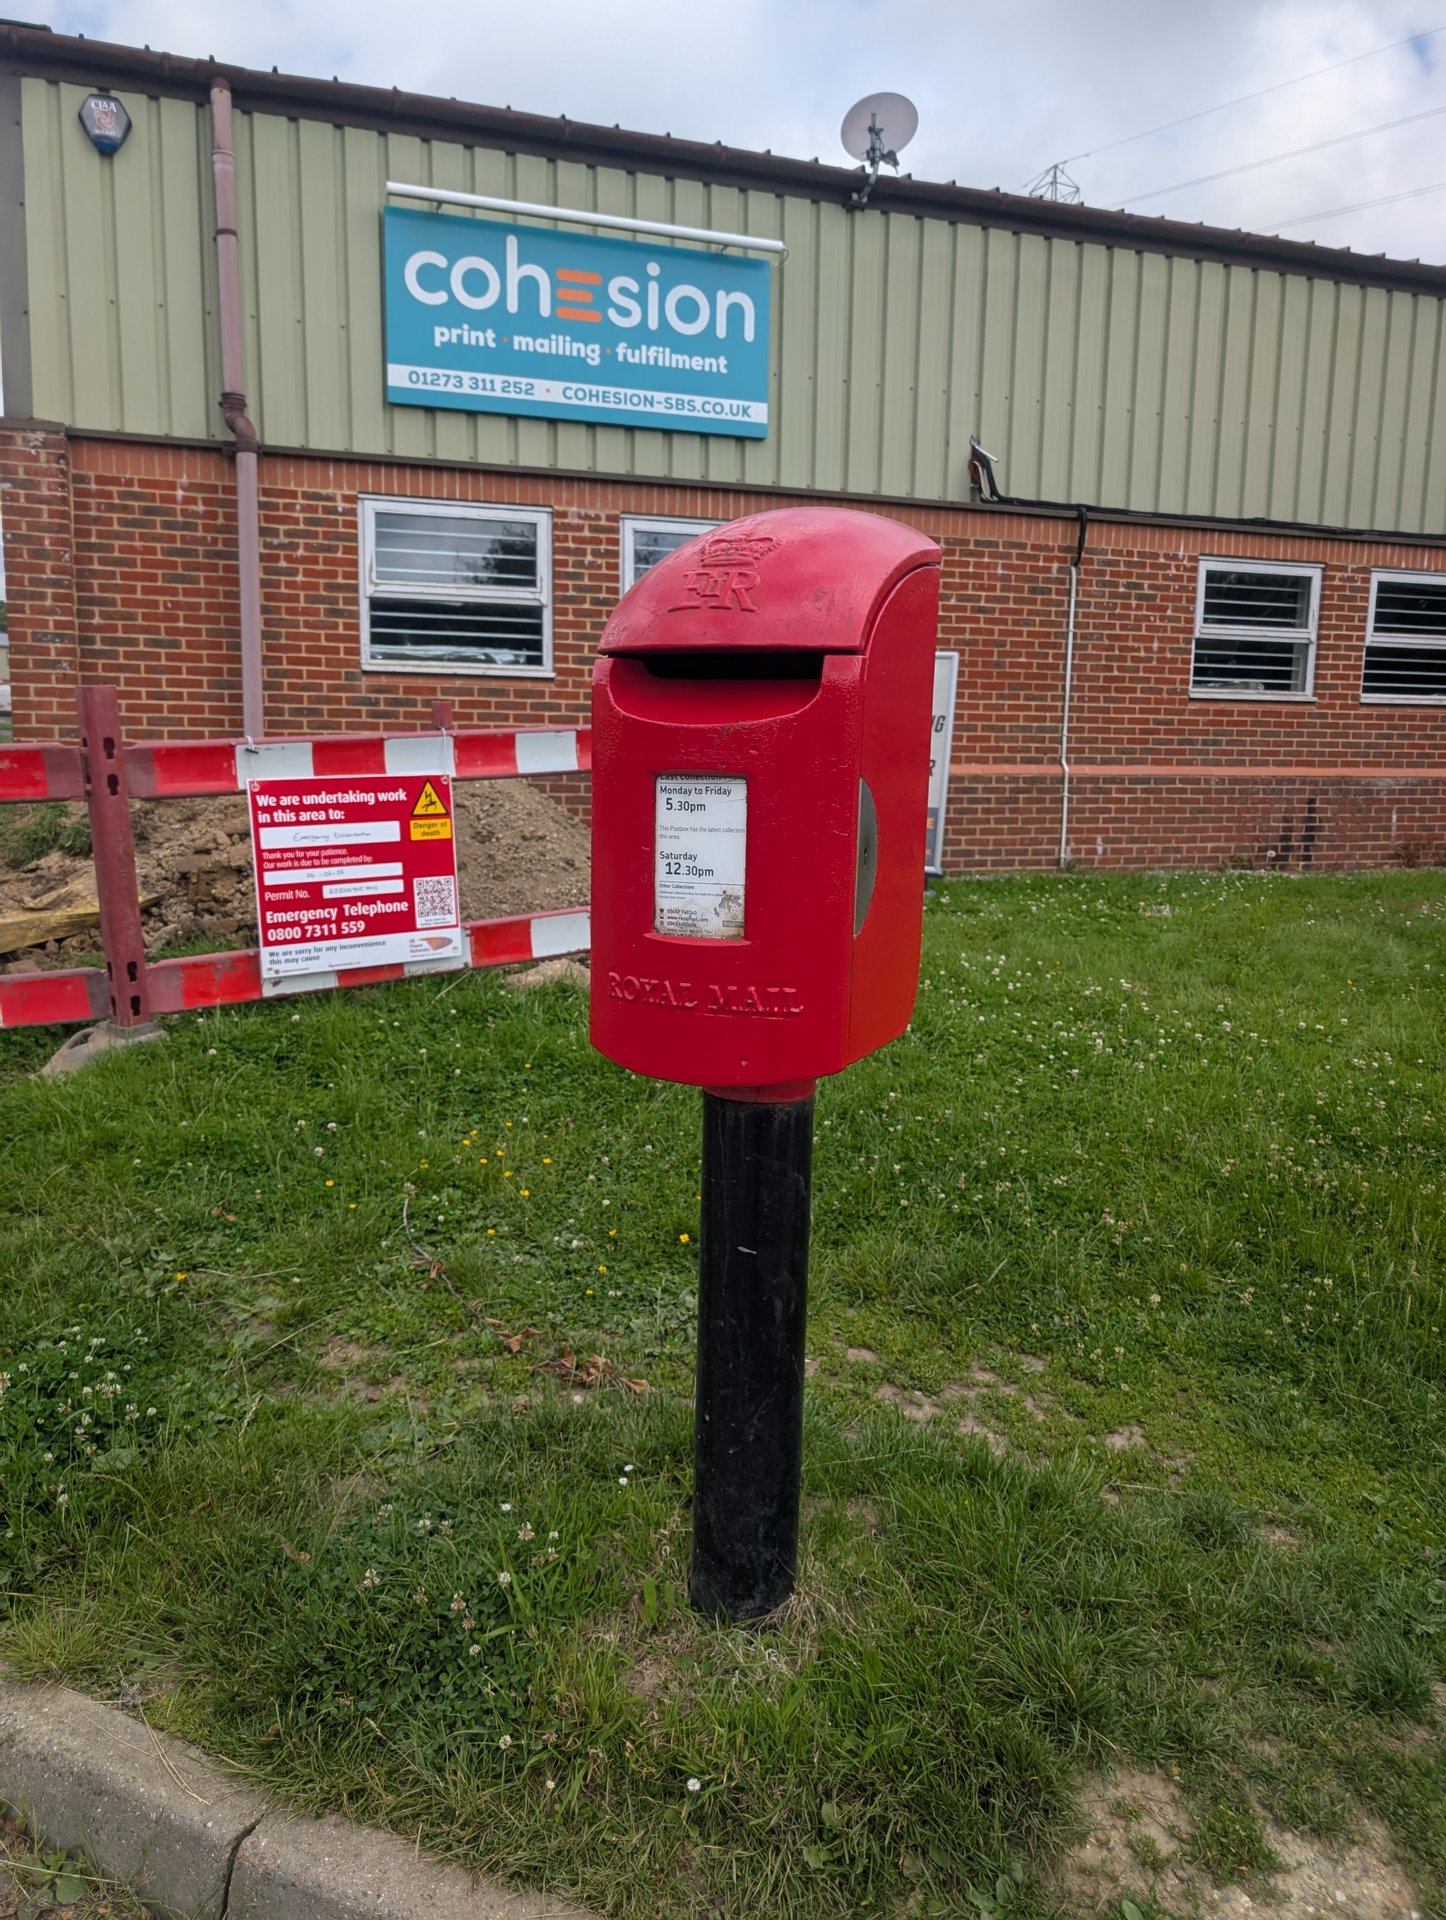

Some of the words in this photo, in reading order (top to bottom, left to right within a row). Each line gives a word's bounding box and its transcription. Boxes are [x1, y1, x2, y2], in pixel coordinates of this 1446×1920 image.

[433, 324, 497, 347] print
[513, 332, 601, 366] mailing
[616, 342, 728, 375] fulfilment
[408, 370, 464, 389] 01273
[468, 373, 496, 392] 311
[500, 376, 535, 396] 252
[562, 386, 752, 419] COHESION-SBS.CO.UK
[256, 794, 277, 807] We
[279, 795, 300, 806] are
[302, 789, 375, 806] undertaking
[377, 788, 407, 802] work
[660, 786, 693, 797] Monday
[694, 786, 703, 795] to
[705, 786, 732, 797] Friday
[666, 797, 706, 814] 5.30pm
[257, 811, 271, 823] in
[273, 809, 296, 823] this
[299, 810, 326, 822] area
[328, 808, 345, 820] to:
[413, 821, 438, 831] Danger
[670, 825, 689, 833] Postbox
[263, 851, 282, 860] Thank
[282, 852, 295, 860] you
[296, 850, 305, 858] for
[306, 850, 320, 859] your
[321, 848, 348, 857] patience.
[263, 861, 276, 869] Our
[276, 860, 292, 868] work
[294, 859, 299, 867] is
[300, 858, 312, 867] due
[313, 858, 320, 866] to
[321, 857, 329, 866] be
[330, 855, 363, 865] completed
[659, 851, 698, 863] Saturday
[665, 861, 714, 878] 12.30pm
[264, 889, 293, 901] Permit
[295, 889, 310, 899] No.
[265, 907, 338, 924] Emergency
[343, 900, 409, 917] Telephone
[267, 926, 302, 941] 0800
[304, 922, 337, 938] 7311
[341, 920, 366, 934] 559
[294, 948, 311, 957] sorry
[325, 945, 338, 953] any
[339, 940, 387, 950] inconvenience
[269, 958, 282, 966] this
[284, 958, 299, 966] may
[301, 955, 320, 963] cause
[609, 971, 698, 1008] ROYAL
[708, 984, 804, 1013] MAIL
